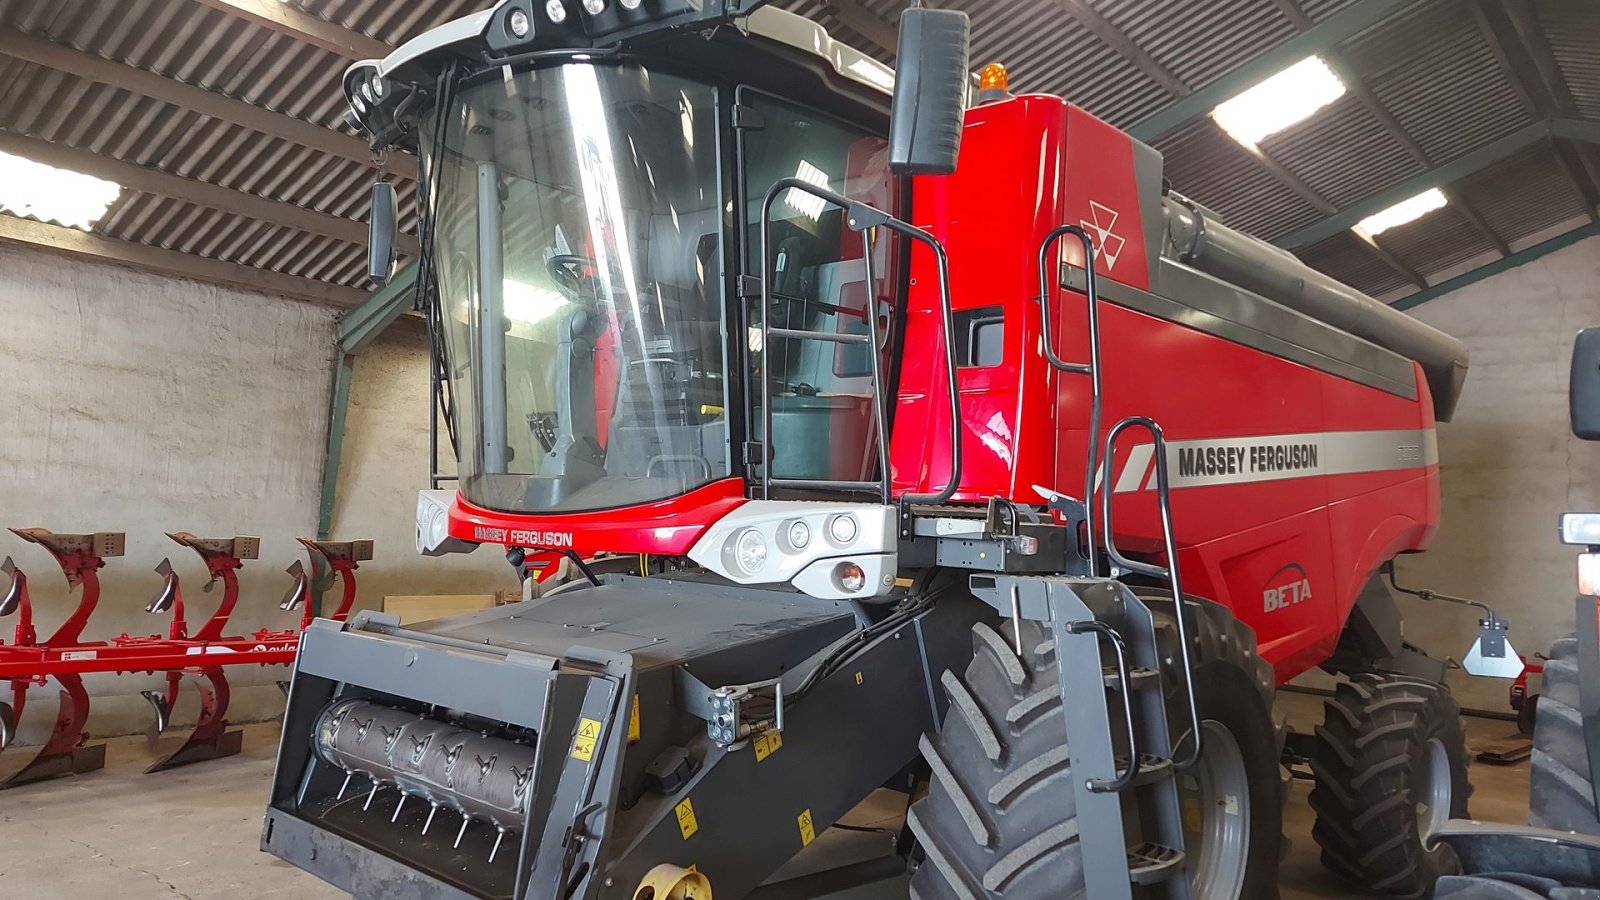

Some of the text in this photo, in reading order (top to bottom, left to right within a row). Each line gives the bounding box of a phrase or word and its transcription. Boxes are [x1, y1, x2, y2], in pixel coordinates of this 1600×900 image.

[1179, 444, 1318, 477] MASSEY FERGUSON
[510, 530, 573, 547] FERGUSON
[1263, 578, 1312, 613] BETA
